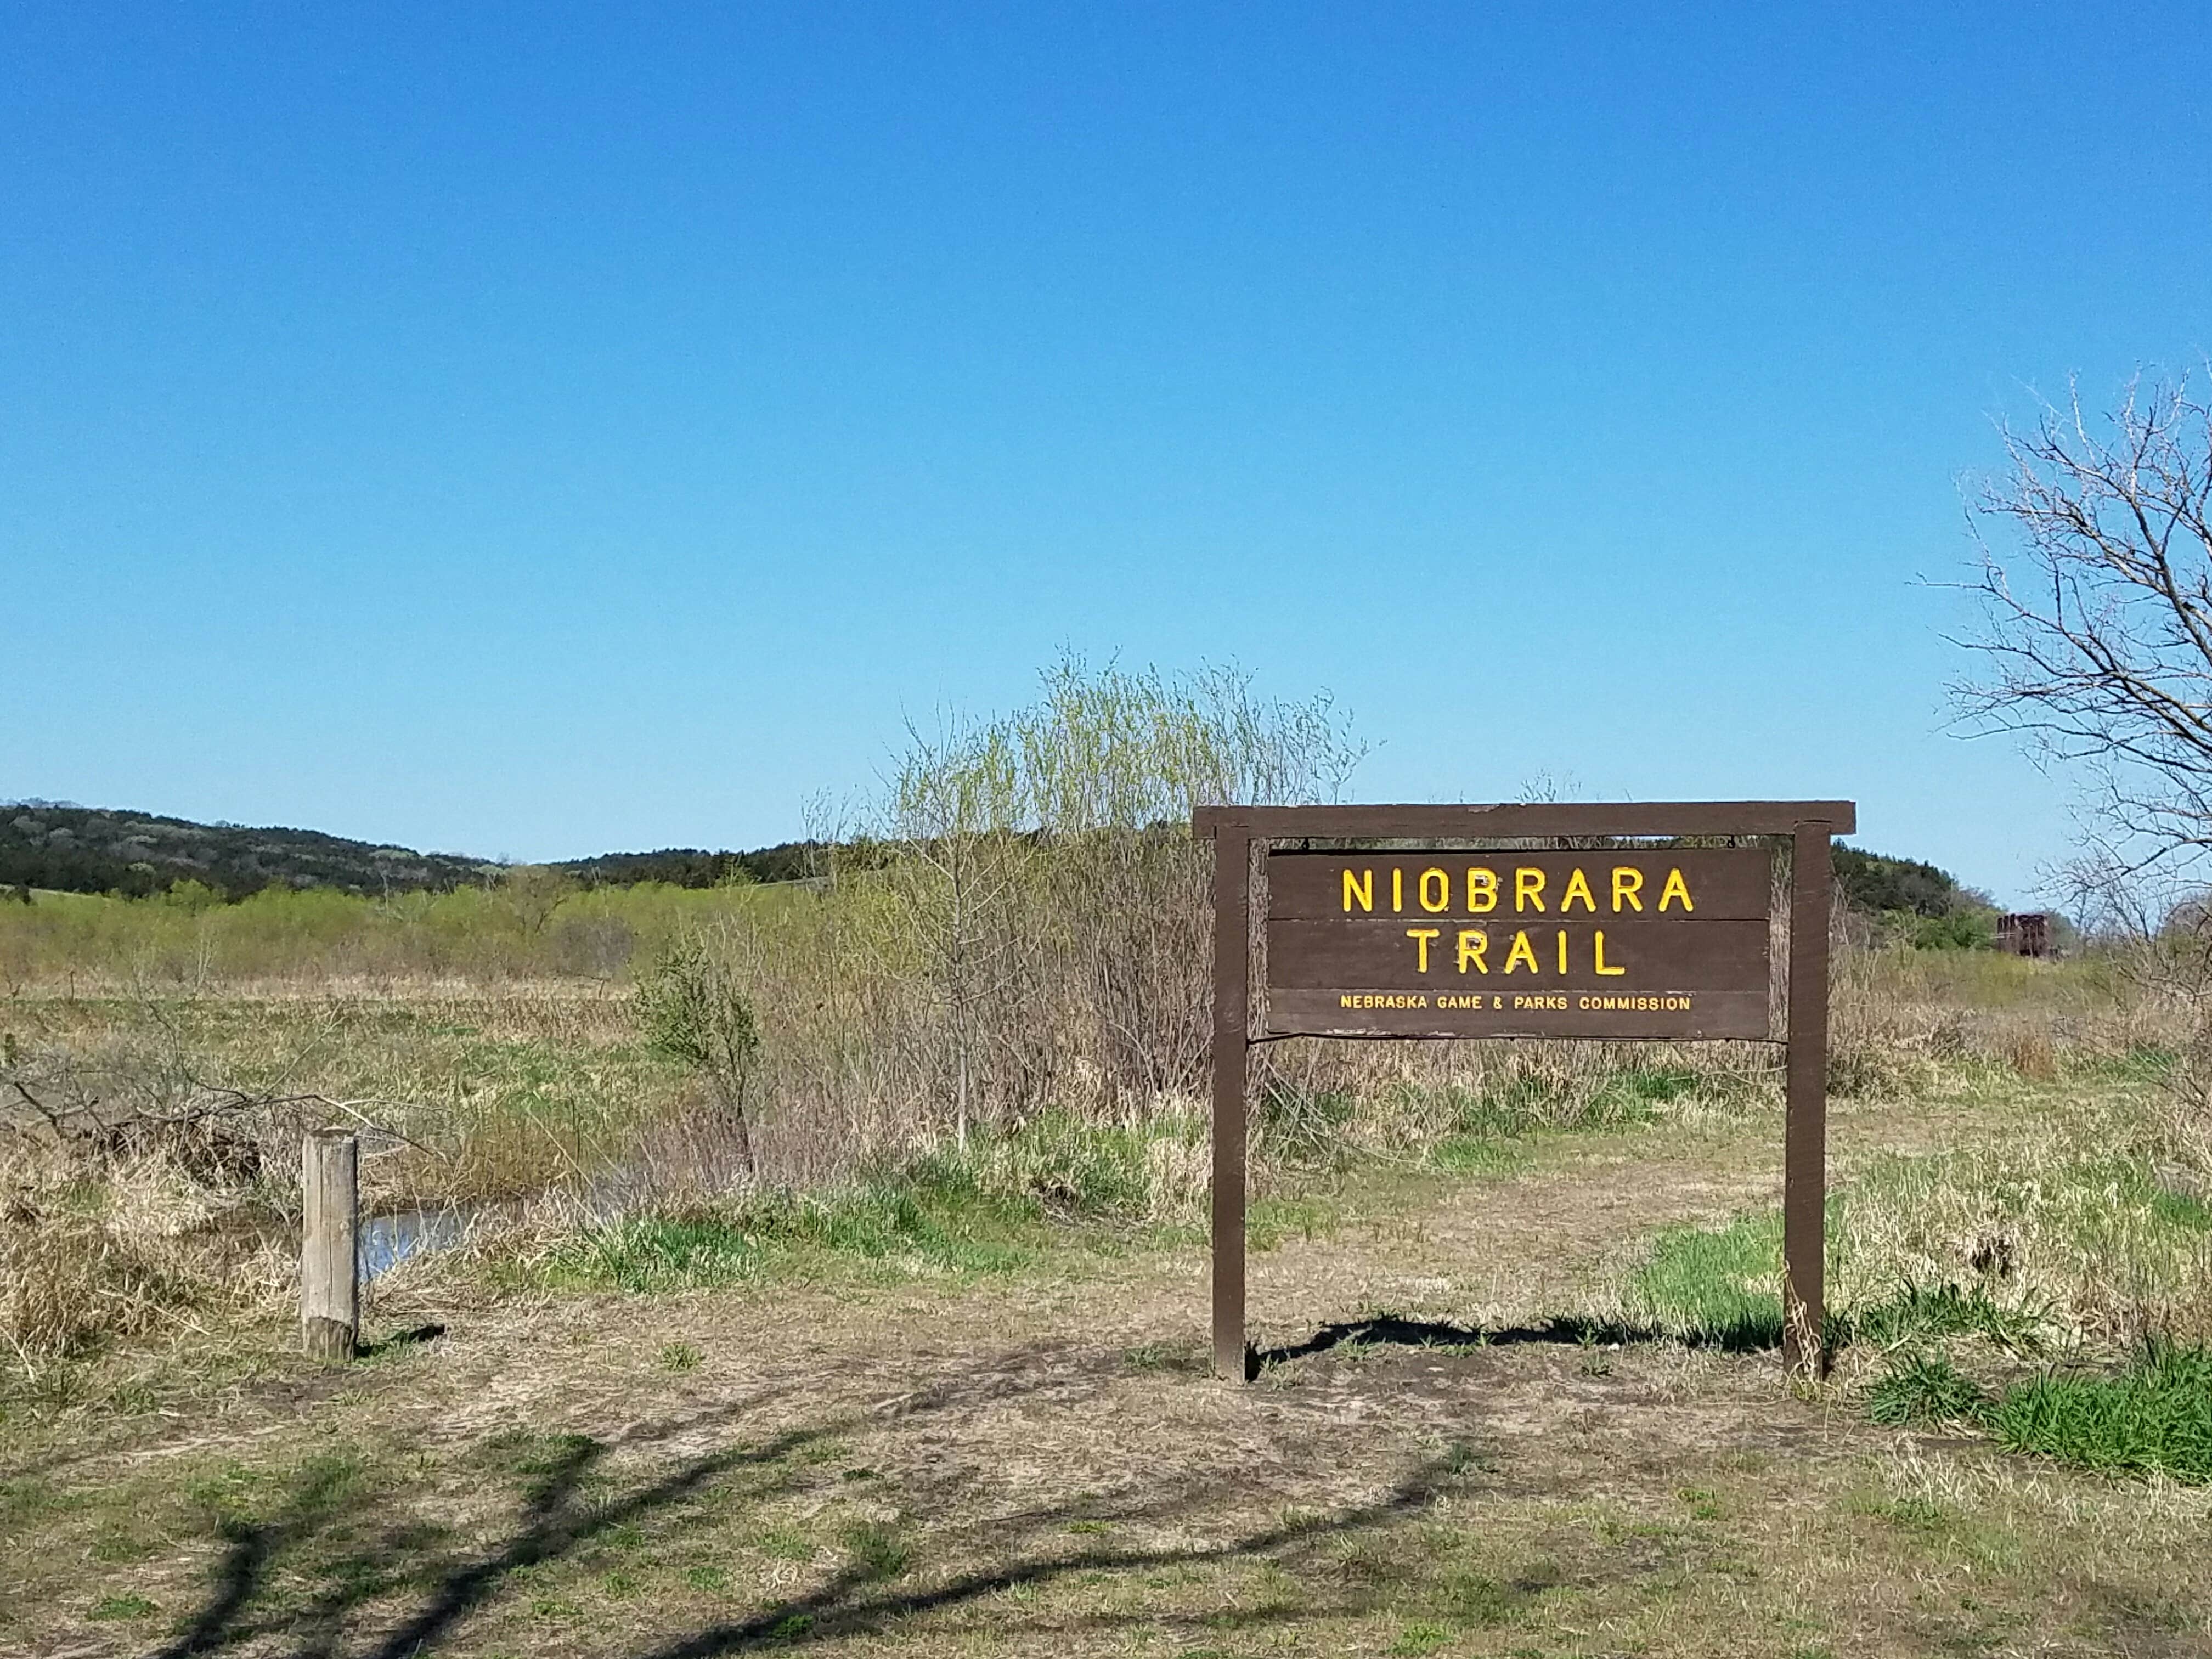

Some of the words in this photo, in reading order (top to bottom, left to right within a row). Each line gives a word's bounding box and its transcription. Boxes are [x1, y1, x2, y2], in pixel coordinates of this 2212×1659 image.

[1342, 867, 1694, 913] NIOBRARA
[1406, 928, 1626, 975] TRAIL
[1340, 994, 1429, 1009] NEBRASKA
[1437, 995, 1482, 1009] GAME
[1493, 995, 1503, 1009] &
[1514, 995, 1568, 1010] PARKS
[1579, 996, 1691, 1011] COMMISSION
